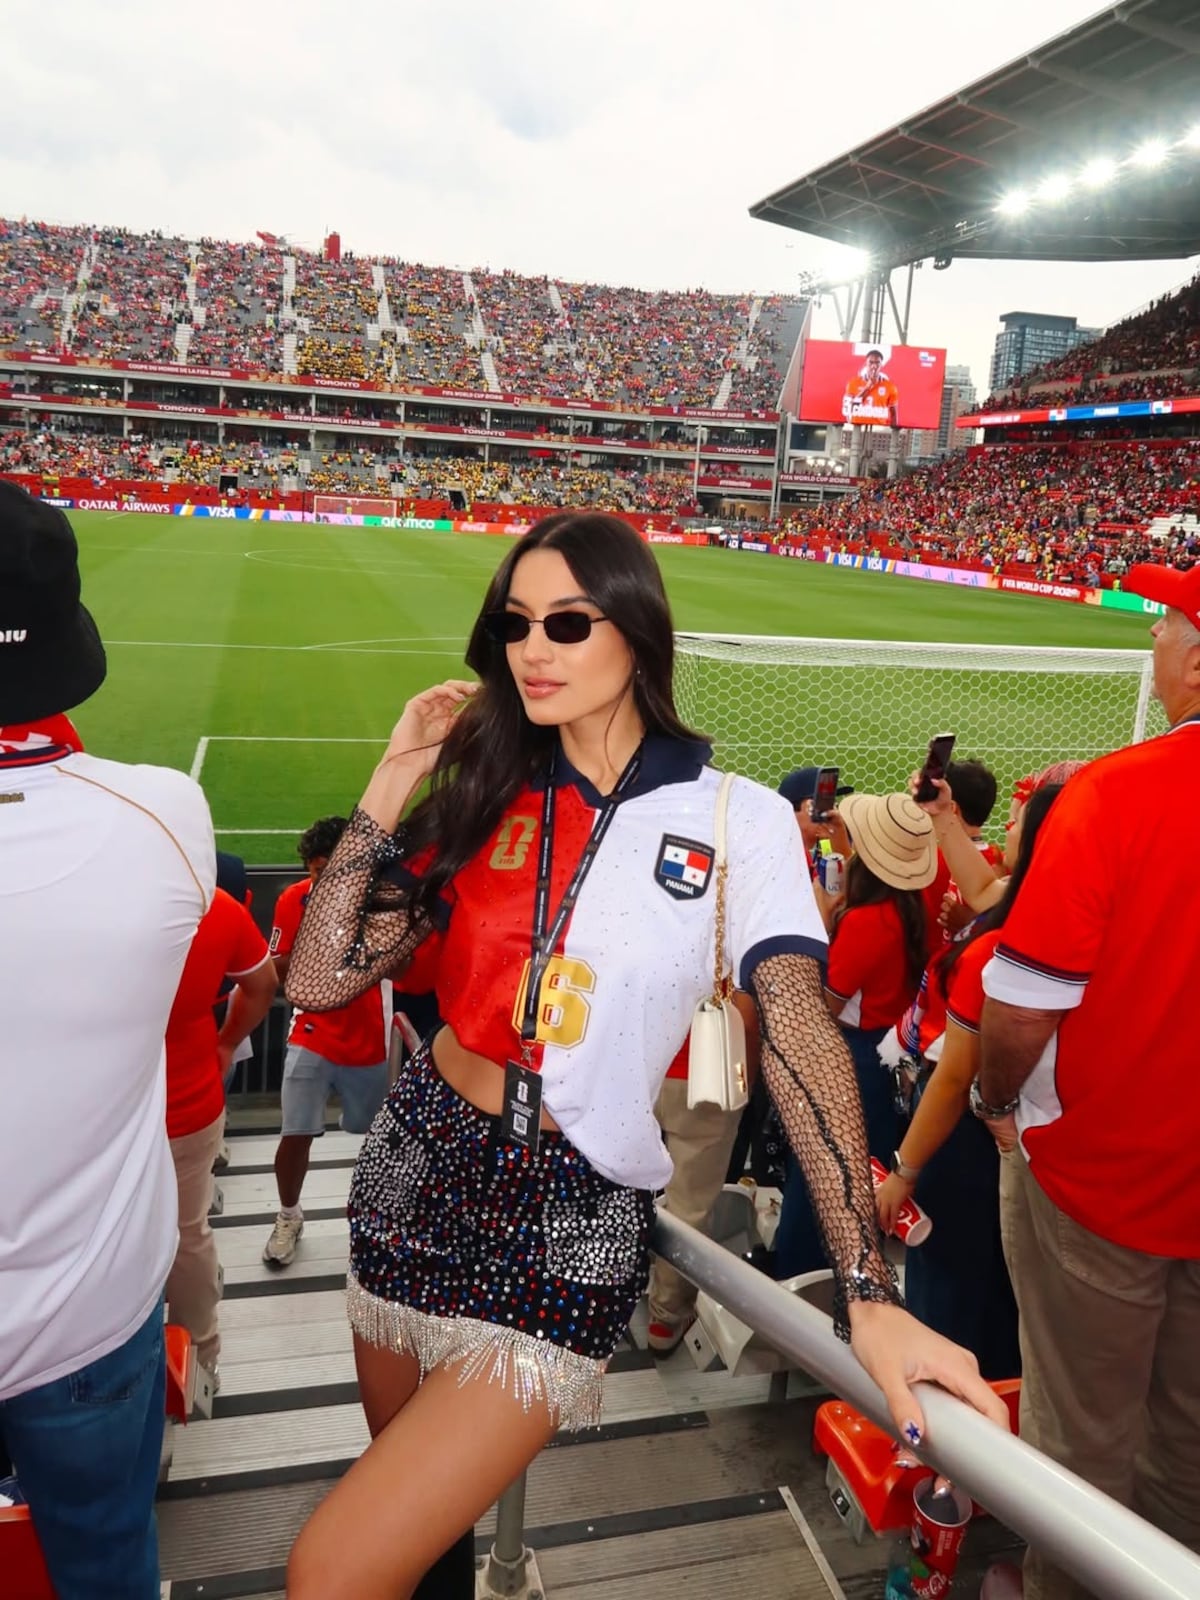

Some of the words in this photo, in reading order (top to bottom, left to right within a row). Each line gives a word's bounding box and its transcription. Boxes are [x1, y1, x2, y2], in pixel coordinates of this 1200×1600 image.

[314, 379, 360, 388] TORONTO
[157, 404, 206, 413] TORONTO
[462, 428, 506, 437] TORONTO
[717, 447, 760, 455] TORONTO
[78, 499, 118, 511] QATAR
[122, 502, 170, 513] AIRWAYS
[206, 506, 236, 518] VISA
[381, 517, 435, 529] aramco
[648, 533, 683, 543] Lenovo
[1002, 578, 1016, 588] FIFA
[1016, 581, 1039, 592] WORLD
[1039, 584, 1053, 594] CUP
[512, 953, 597, 1050] 6
